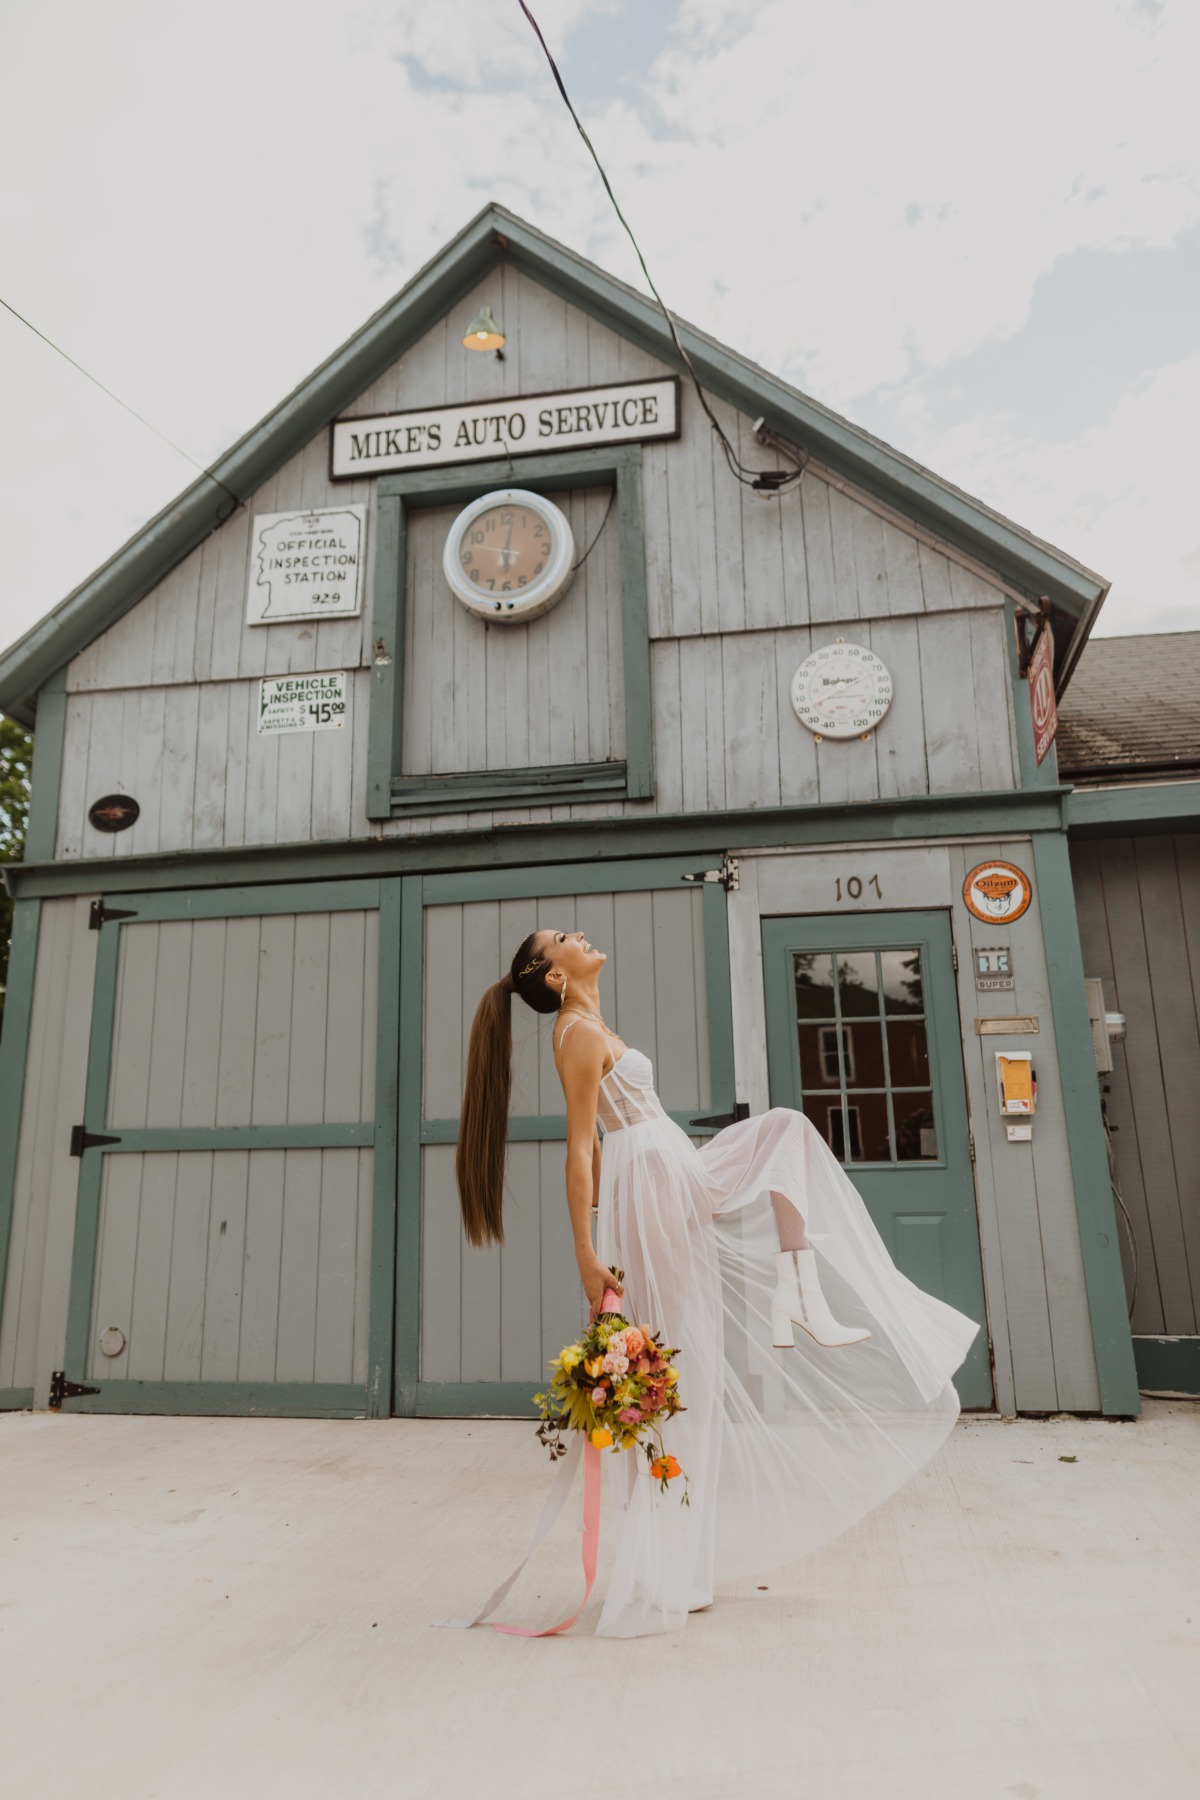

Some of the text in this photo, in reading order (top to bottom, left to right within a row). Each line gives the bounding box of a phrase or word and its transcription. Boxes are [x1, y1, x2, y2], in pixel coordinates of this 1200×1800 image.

[350, 396, 659, 461] MIKE'S AUTO SERVICE
[486, 518, 496, 532] 11
[500, 512, 513, 525] 12
[522, 515, 526, 528] 1
[534, 524, 543, 538] 2
[277, 538, 346, 551] OFFICIAL
[470, 531, 484, 545] 10
[541, 543, 550, 556] 3
[270, 554, 356, 569] INSPECTION
[463, 551, 473, 564] 9
[284, 571, 346, 584] STATION
[487, 578, 496, 591] 7
[501, 581, 512, 592] 6
[312, 592, 340, 604] 929
[832, 648, 844, 656] 40
[799, 670, 809, 678] 10
[276, 677, 337, 692] VEHICLE
[270, 689, 342, 704] INSPECTION
[868, 709, 882, 717] 110
[835, 874, 882, 902] 101
[976, 879, 1017, 887] Oilzum
[979, 980, 1011, 988] SUPER
